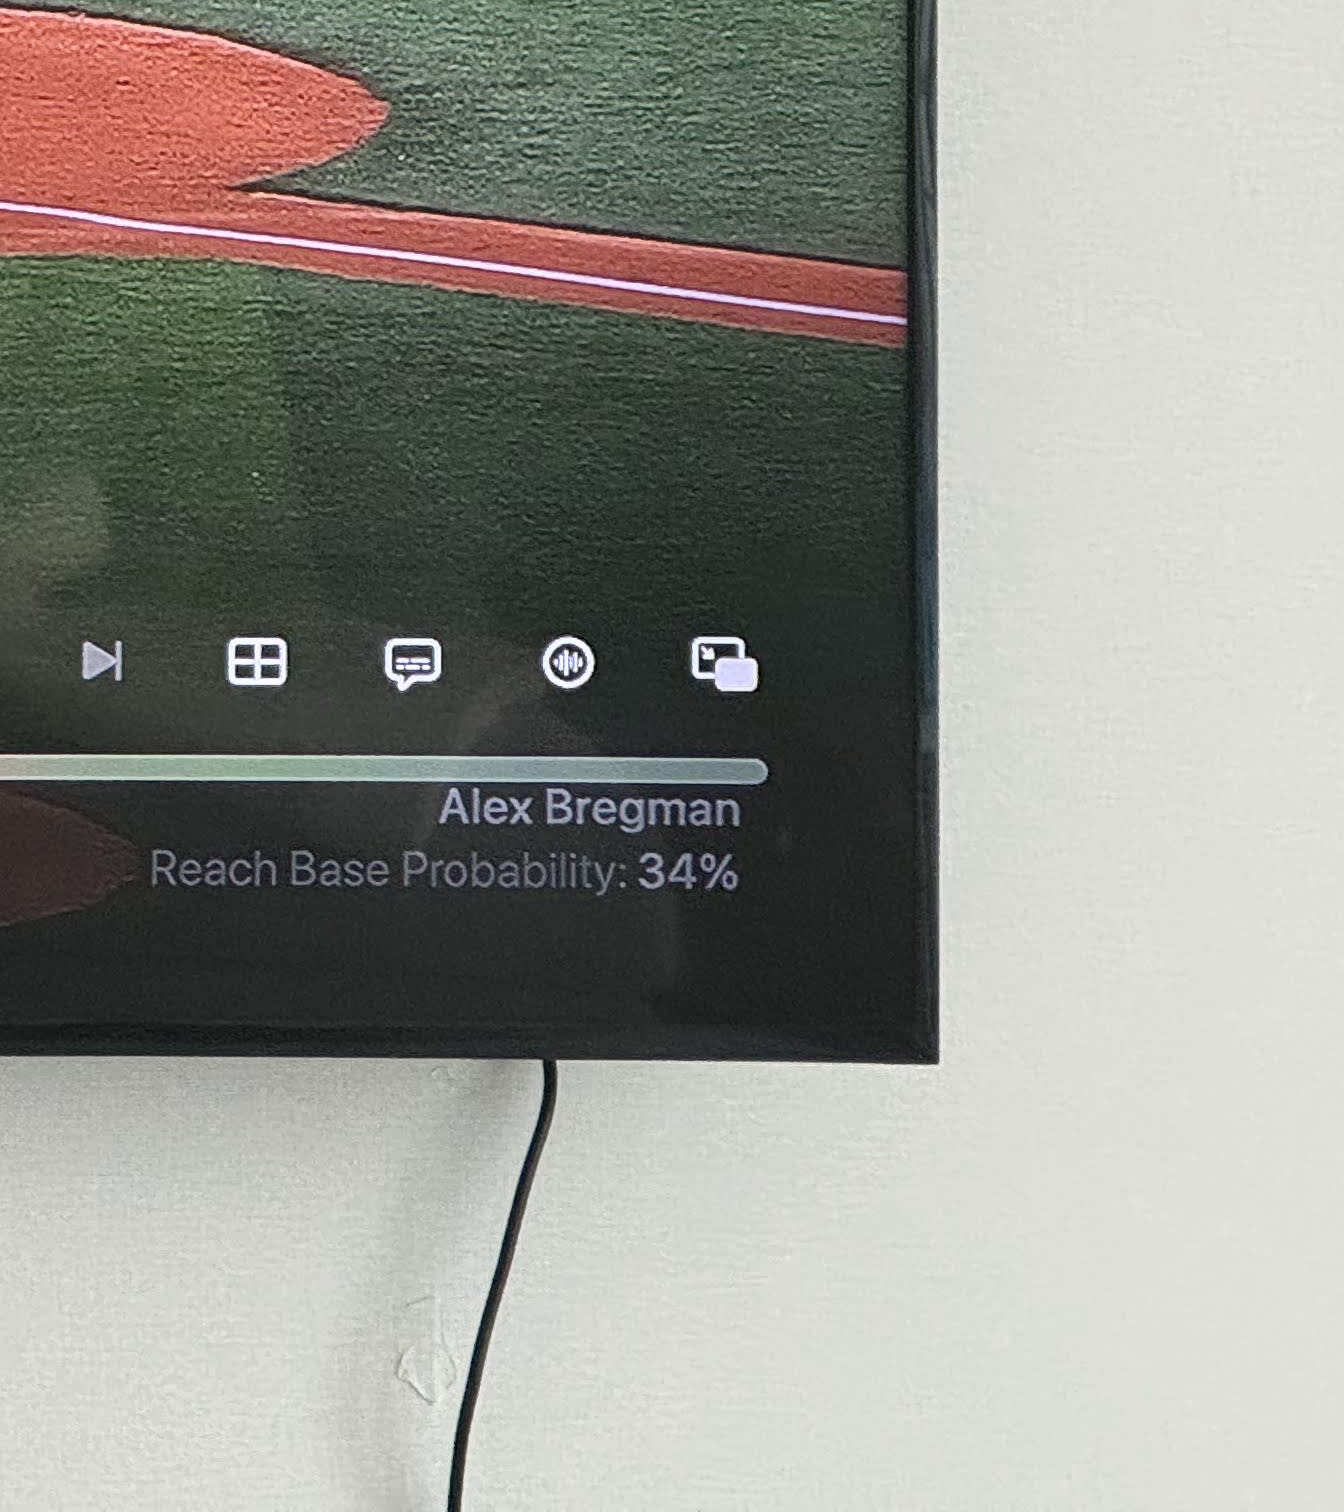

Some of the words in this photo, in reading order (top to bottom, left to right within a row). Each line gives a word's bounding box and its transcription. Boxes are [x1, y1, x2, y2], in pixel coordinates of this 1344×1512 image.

[439, 788, 533, 826] Alex
[545, 787, 741, 834] Bregman
[151, 849, 278, 887] Reach
[291, 850, 390, 888] Base
[402, 850, 627, 897] Probability:
[638, 852, 739, 890] 34%
